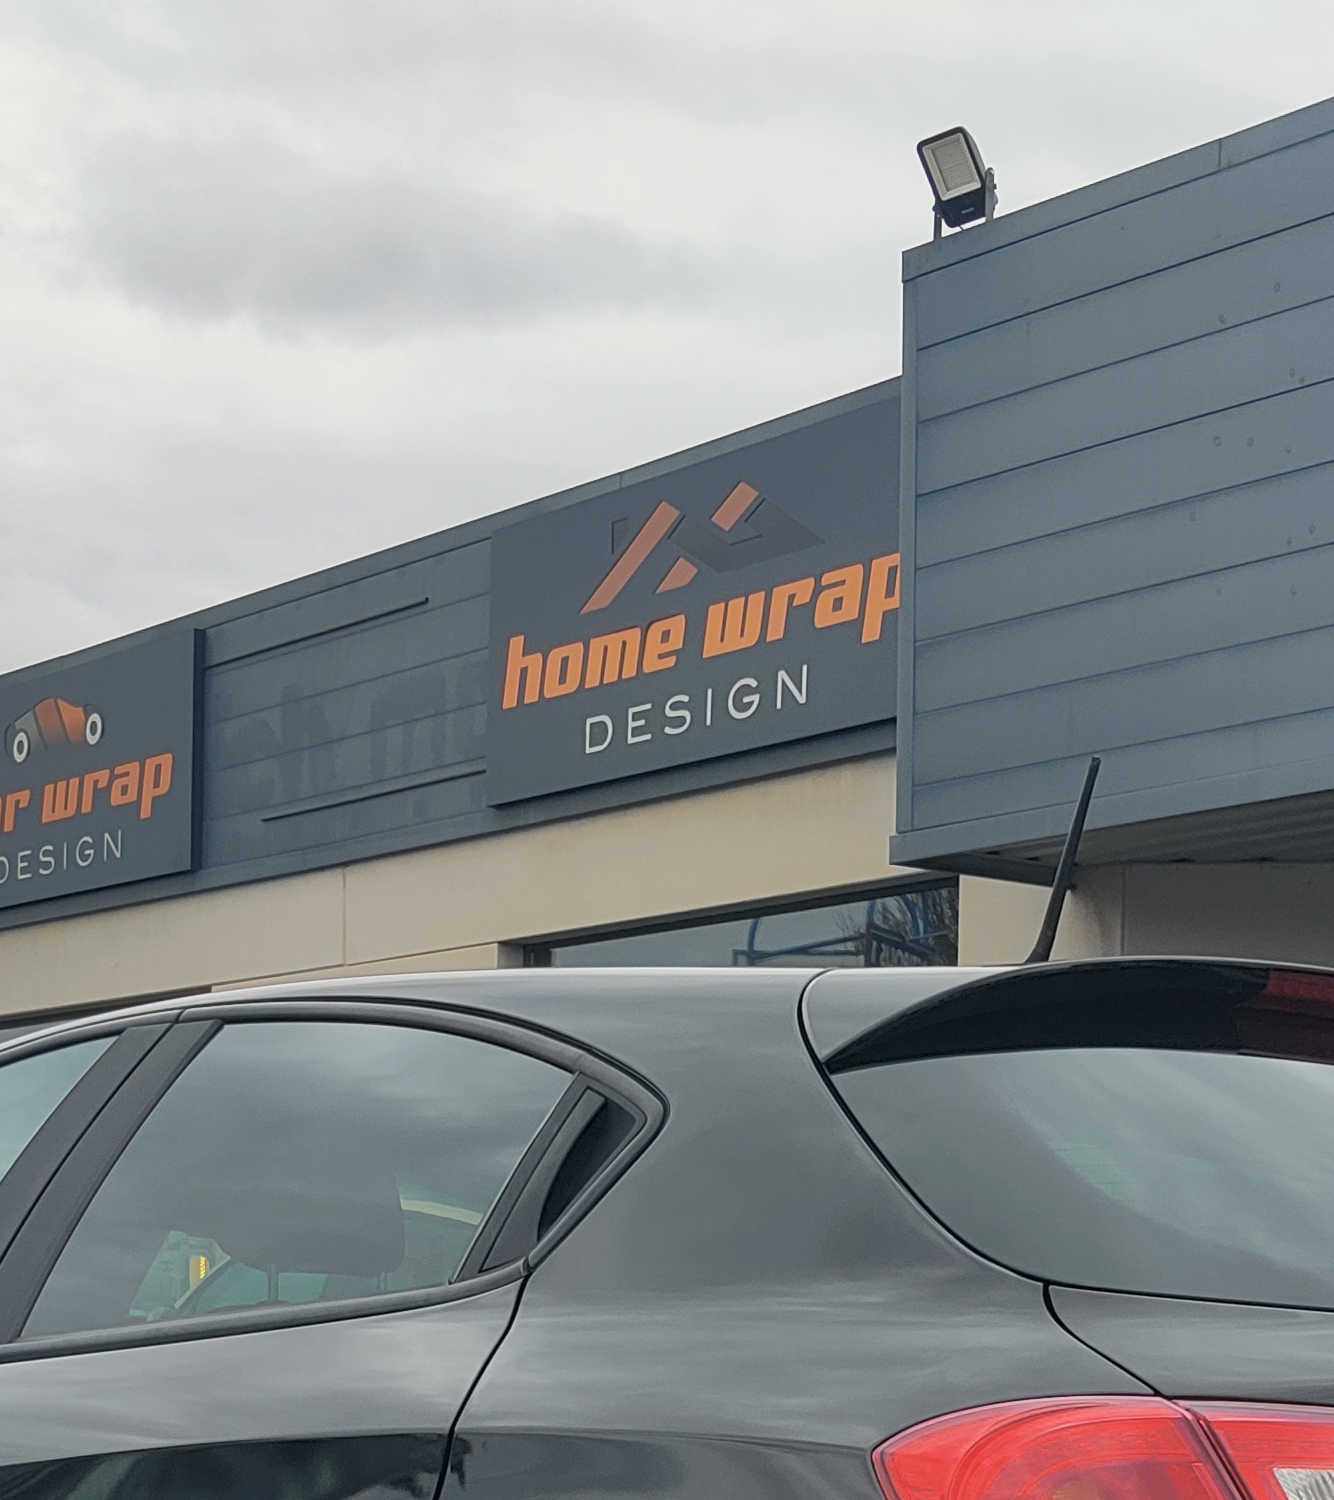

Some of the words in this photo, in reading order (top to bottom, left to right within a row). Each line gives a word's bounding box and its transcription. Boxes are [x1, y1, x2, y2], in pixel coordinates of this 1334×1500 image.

[502, 613, 686, 710] home
[702, 552, 900, 659] wrap
[584, 664, 808, 754] DESIGN
[41, 752, 173, 824] wrap
